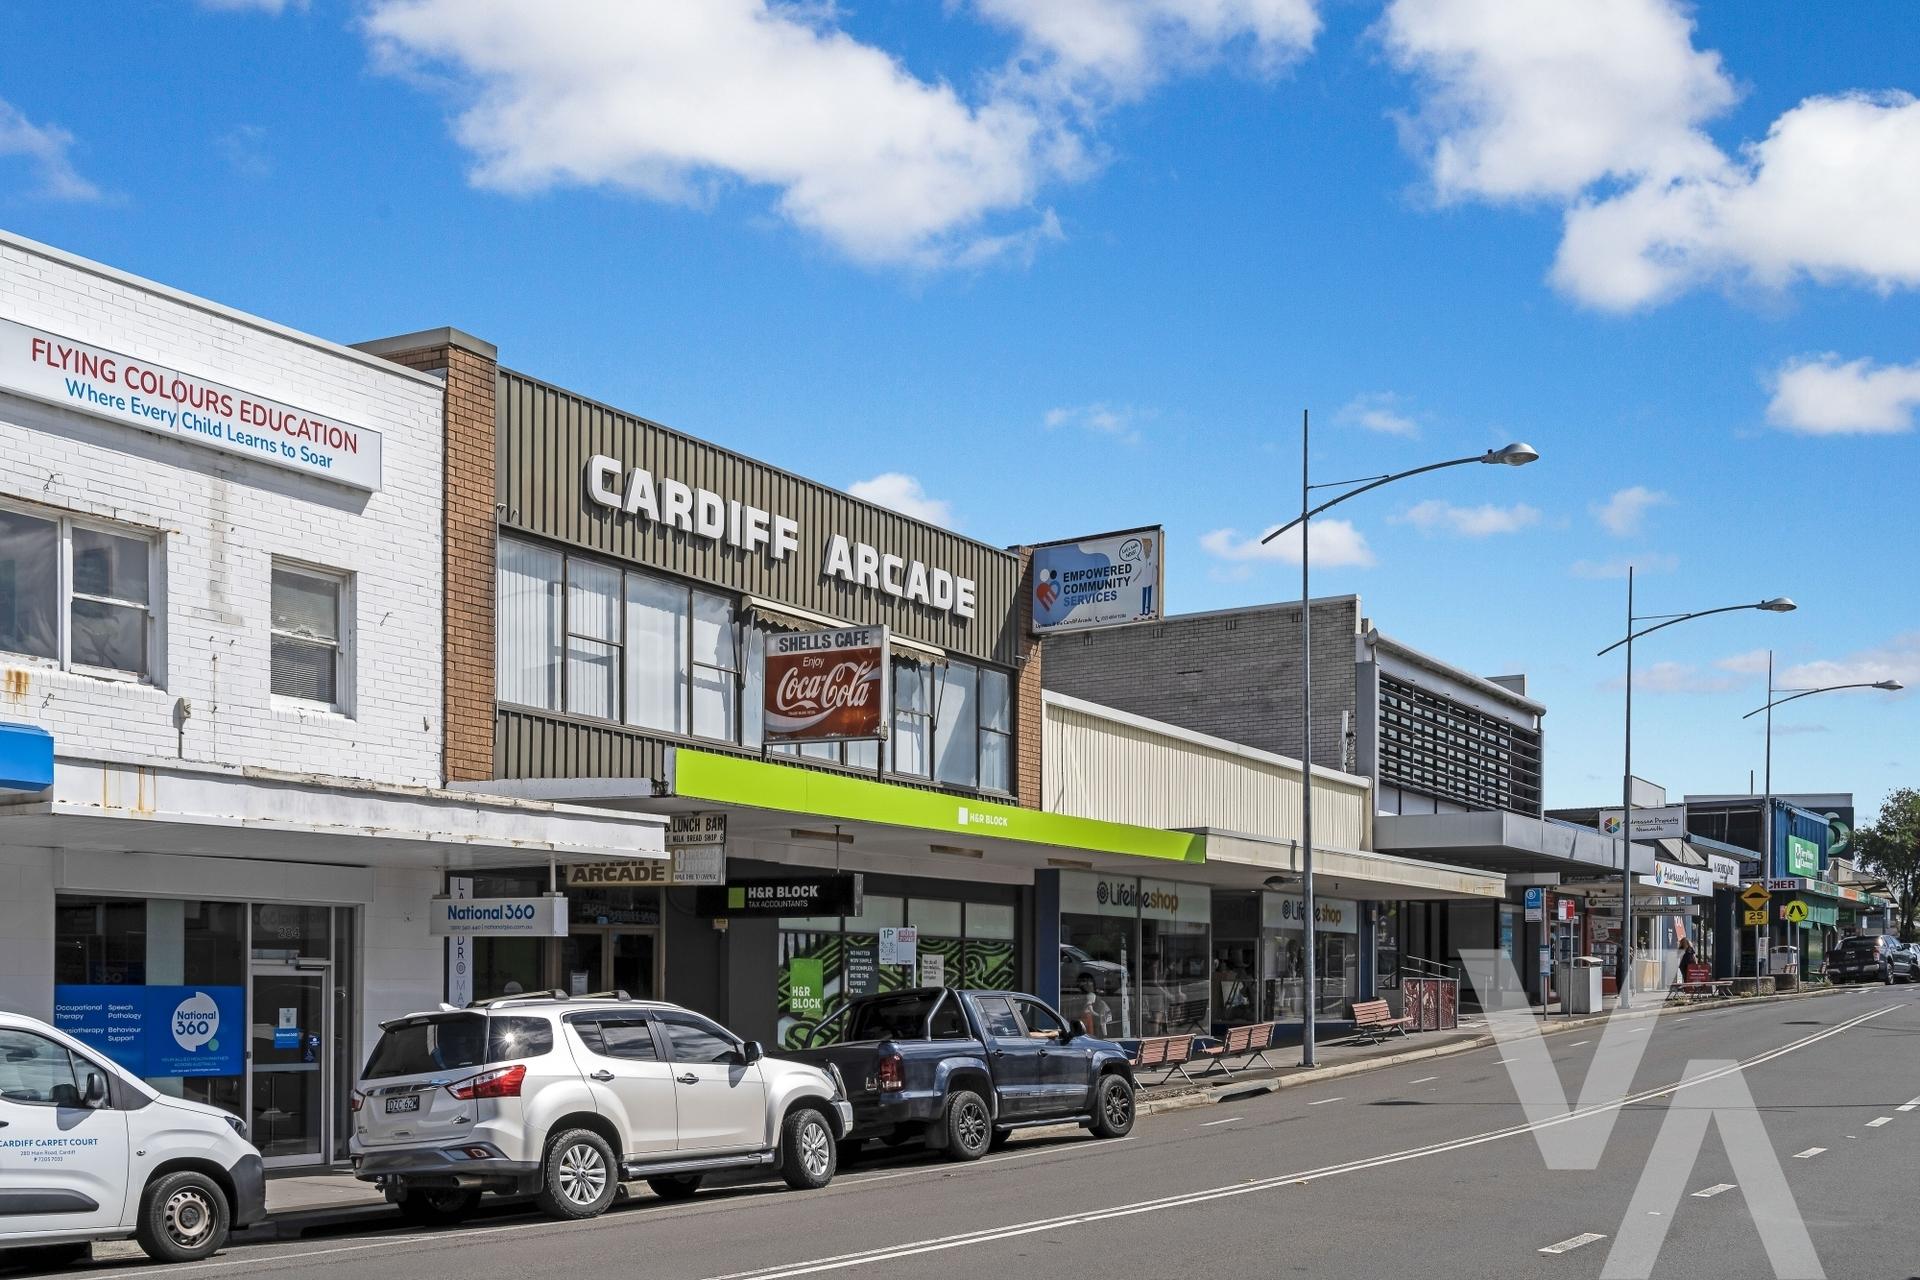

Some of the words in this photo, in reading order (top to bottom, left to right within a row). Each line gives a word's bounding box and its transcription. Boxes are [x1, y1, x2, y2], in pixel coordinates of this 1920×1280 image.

[32, 338, 116, 384] FLYING
[124, 366, 233, 418] COLOURS
[240, 400, 357, 454] EDUCATION
[65, 378, 126, 411] Where
[131, 396, 177, 428] Every
[182, 411, 222, 438] Child
[227, 424, 277, 453] Learns
[281, 441, 296, 458] to
[300, 446, 333, 469] Soar
[586, 454, 799, 560] CARDIFF
[823, 534, 976, 619] ARCADE
[1063, 563, 1132, 582] EMPOWERED
[1063, 576, 1131, 595] COMMUNITY
[1063, 590, 1117, 607] SERVICES
[778, 634, 831, 652] SHELLS
[835, 631, 869, 647] CAFE
[803, 657, 824, 668] Enjoy
[777, 661, 873, 711] Coca-Cola
[673, 818, 700, 832] LUNCH
[706, 816, 723, 831] BAR
[970, 812, 984, 823] H&R
[985, 815, 1008, 827] BLOCK
[571, 867, 664, 882] ARCADE
[748, 886, 773, 898] H&R
[777, 885, 818, 898] BLOCK
[748, 900, 761, 908] TAX
[761, 899, 808, 908] ACCOUNTANTS
[1749, 911, 1763, 920] 25
[792, 986, 811, 997] H&R
[56, 1004, 102, 1012] Occupational
[108, 1004, 133, 1012] Speech
[792, 998, 821, 1009] BLOCK
[56, 1013, 84, 1021] Therapy
[108, 1012, 141, 1021] Pathology
[177, 1010, 216, 1020] National
[63, 1027, 104, 1035] ysiotherapy
[176, 1020, 209, 1036] 360
[108, 1035, 135, 1043] Support
[35, 1139, 67, 1147] CARPET
[70, 1138, 98, 1146] COURT
